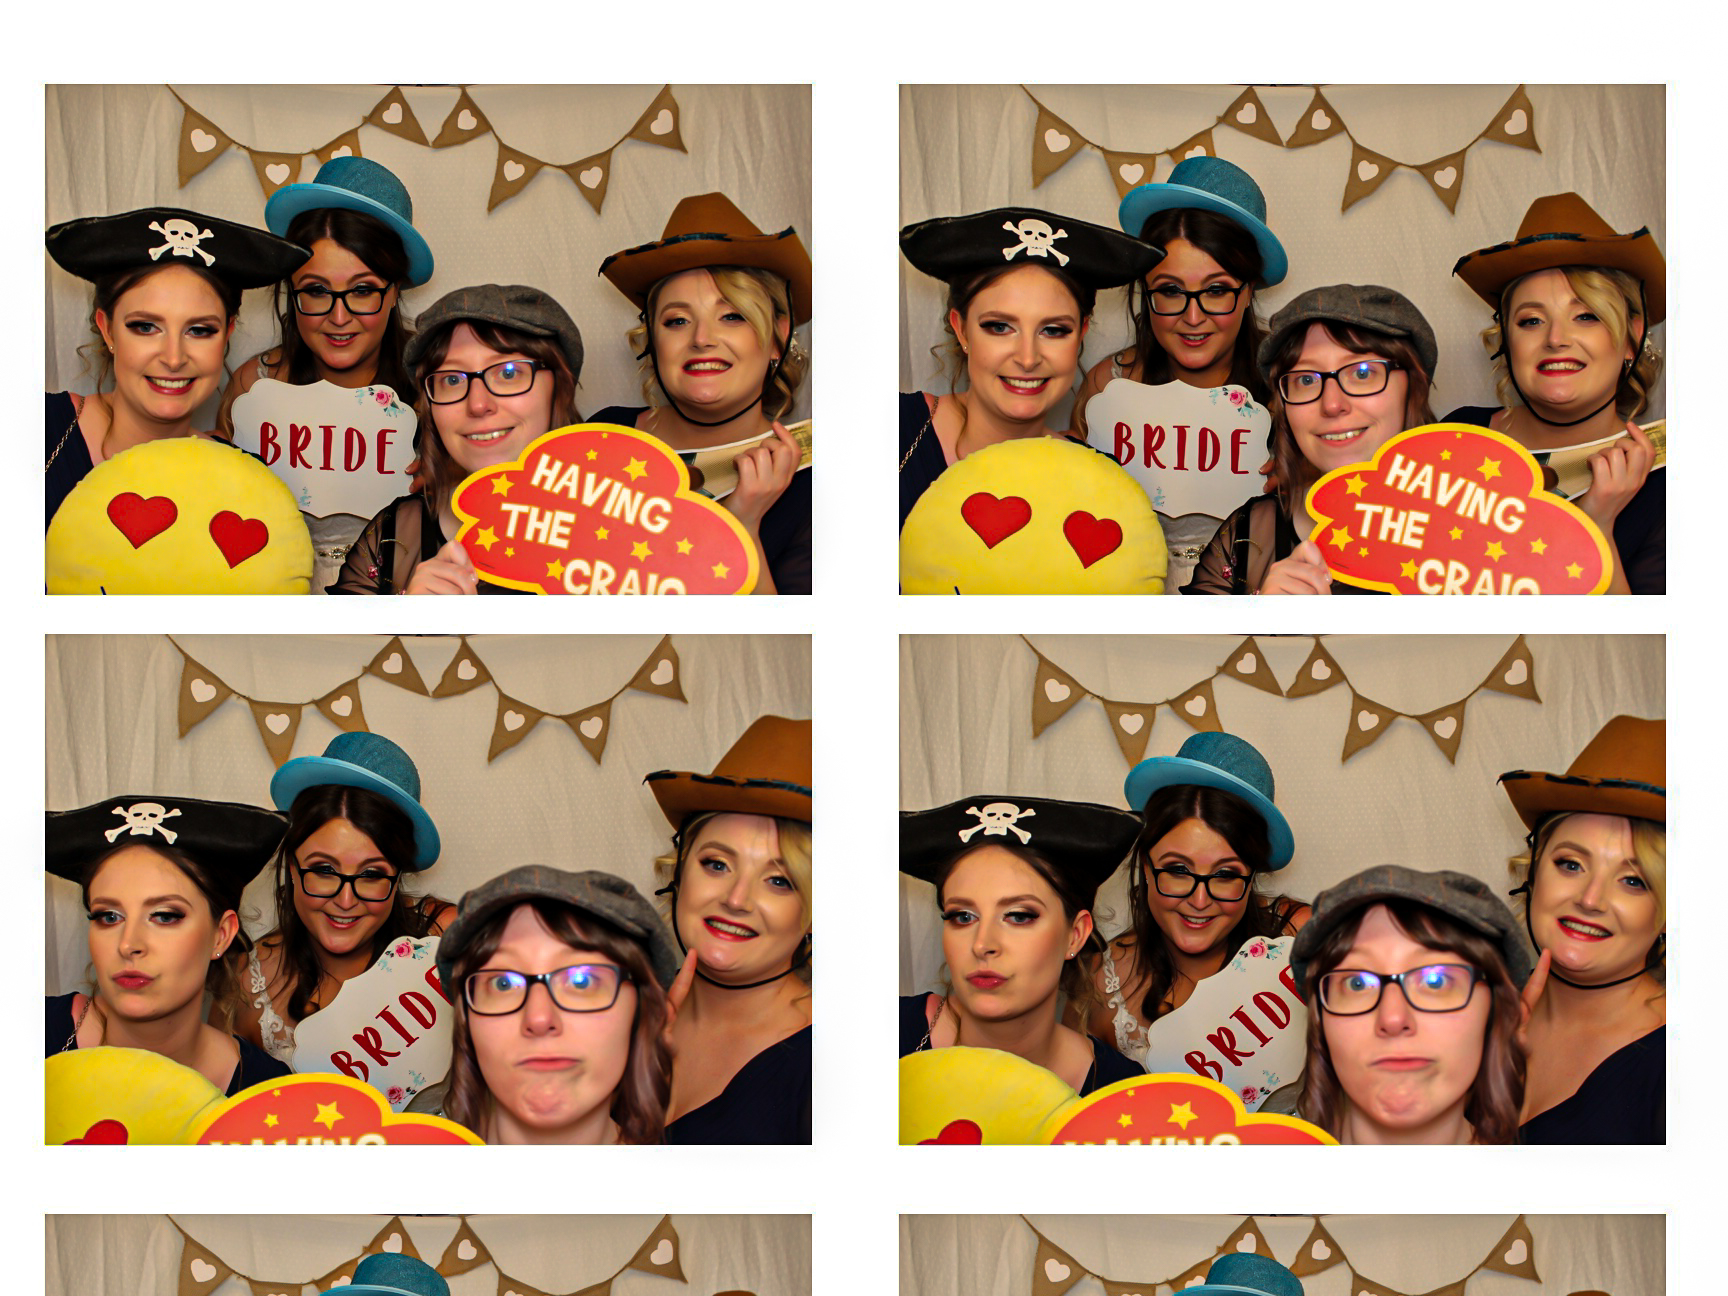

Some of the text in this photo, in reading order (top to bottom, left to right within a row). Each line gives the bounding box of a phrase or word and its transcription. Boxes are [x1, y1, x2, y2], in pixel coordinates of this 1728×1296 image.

[259, 421, 398, 475] BRIDE
[1113, 421, 1252, 475] BRIDE
[530, 453, 673, 535] HAVING
[1384, 453, 1527, 535] HAVING
[500, 502, 576, 550] THE
[1354, 502, 1430, 550] THE
